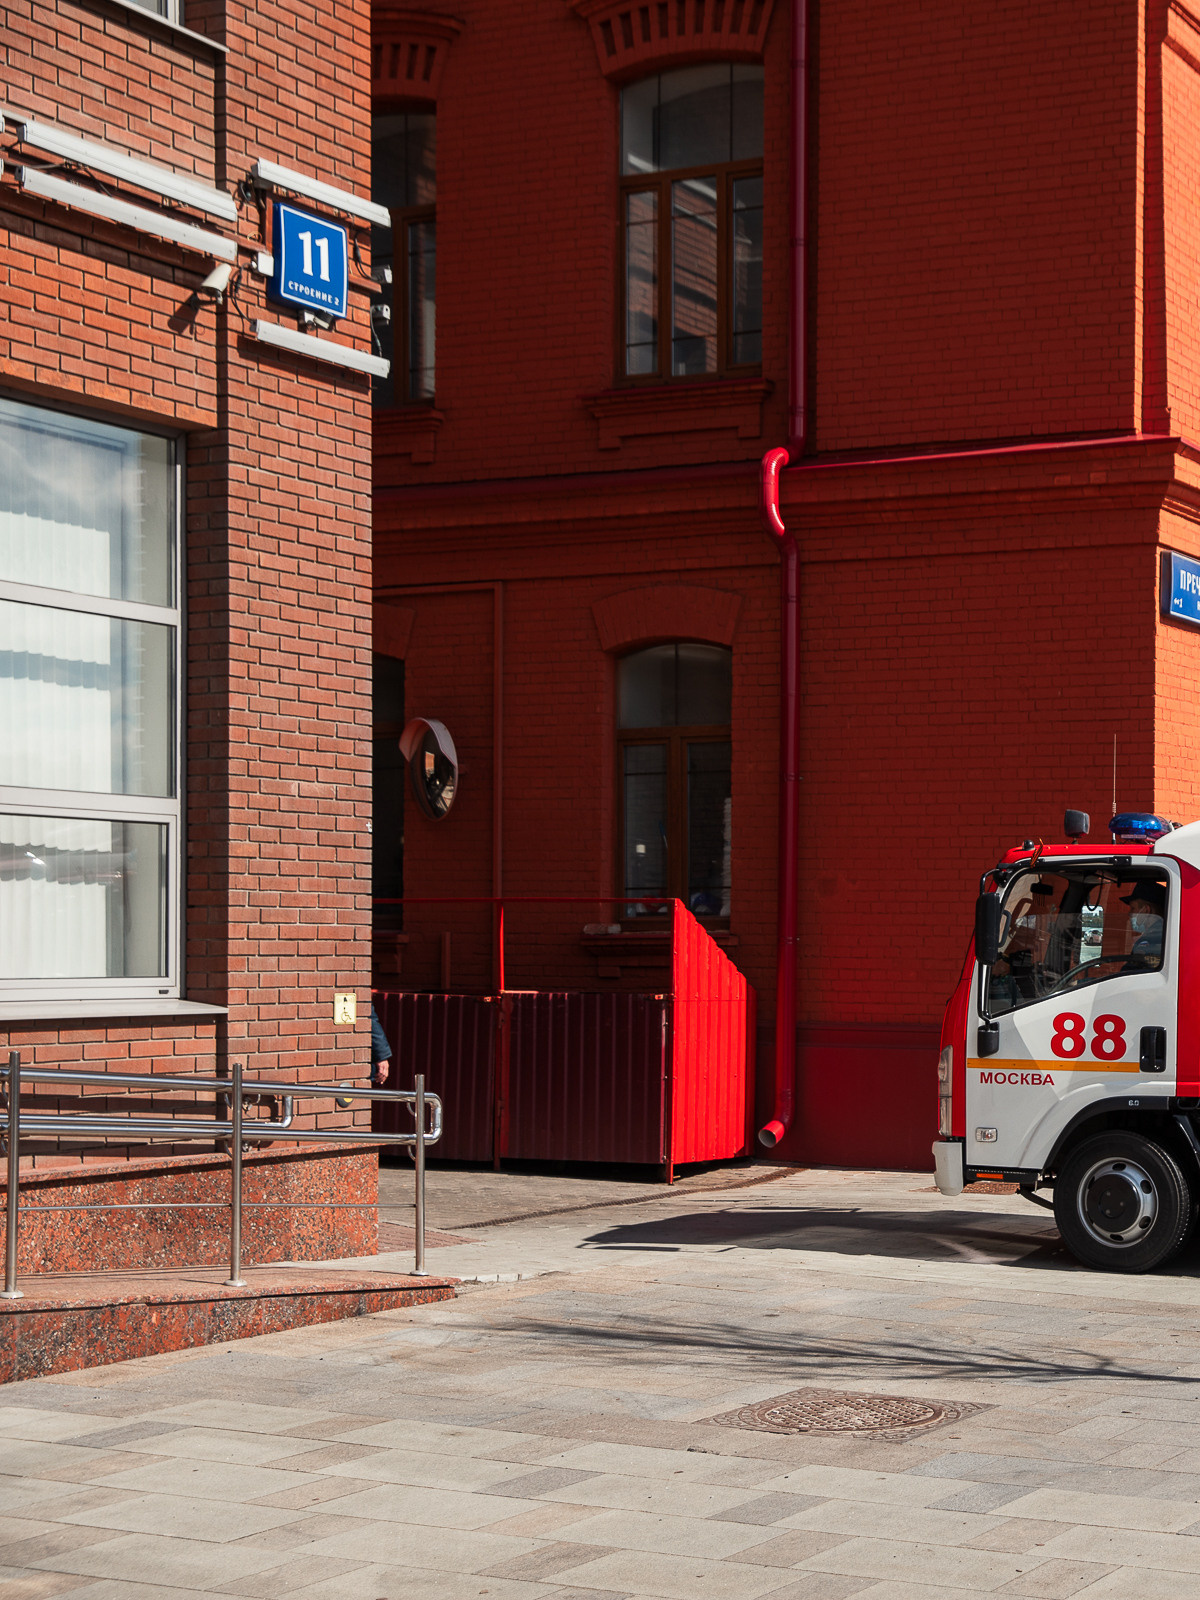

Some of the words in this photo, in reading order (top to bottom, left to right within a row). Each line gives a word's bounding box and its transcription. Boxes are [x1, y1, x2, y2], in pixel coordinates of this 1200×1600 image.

[298, 231, 330, 282] 11
[288, 281, 333, 303] СТРОЕНИЕ
[1051, 1012, 1127, 1061] 88
[980, 1072, 1055, 1086] МОСКВА
